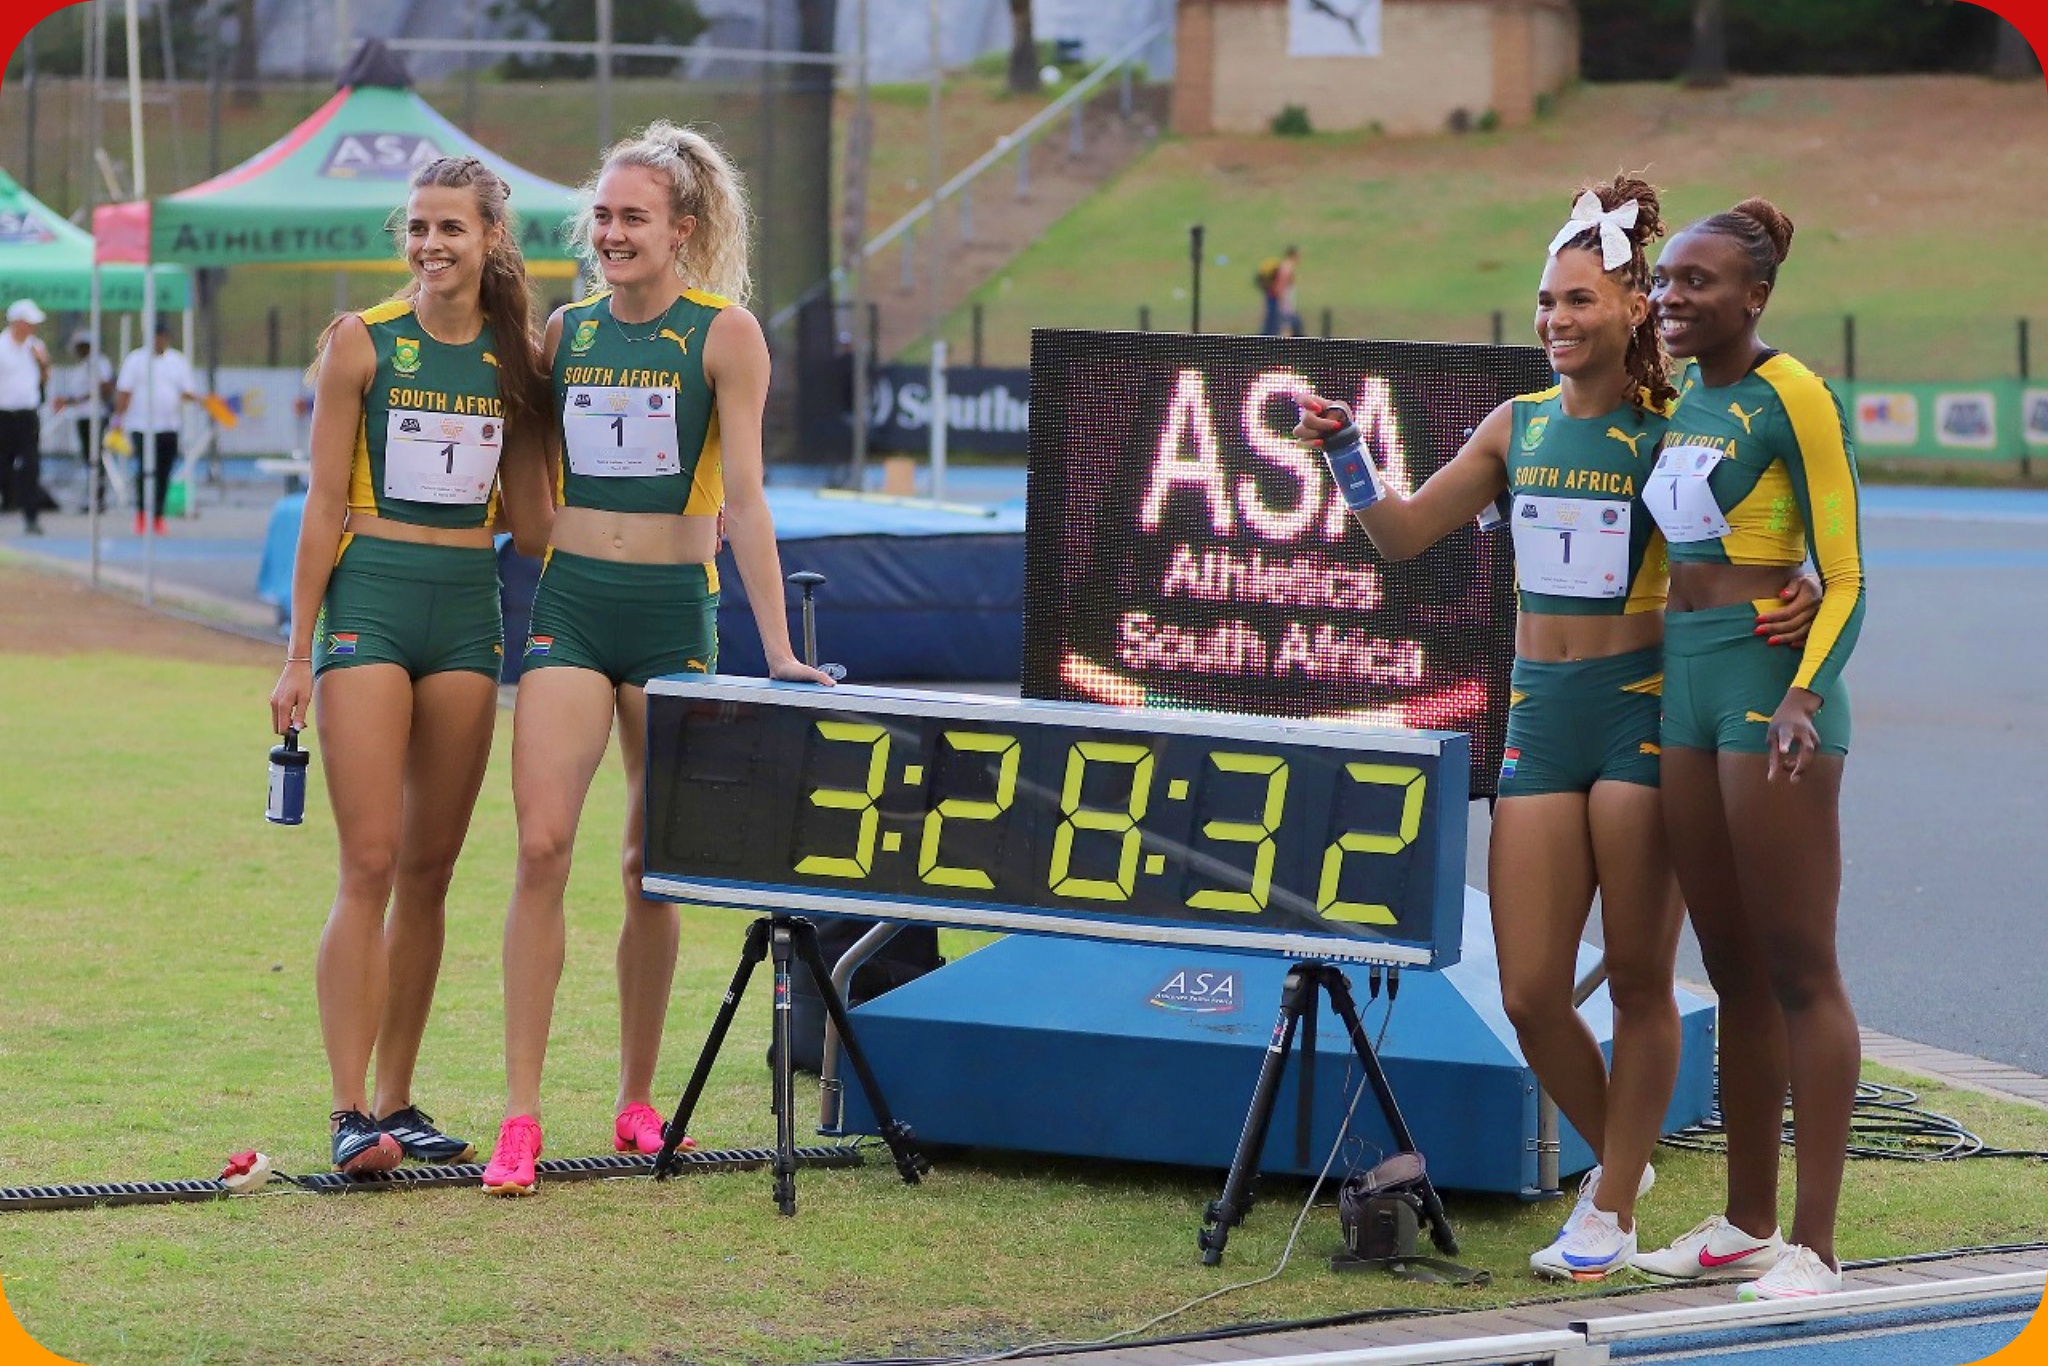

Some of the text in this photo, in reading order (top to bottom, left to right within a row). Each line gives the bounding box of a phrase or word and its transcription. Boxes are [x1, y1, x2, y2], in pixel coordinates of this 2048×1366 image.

[332, 135, 443, 165] ASA
[564, 366, 682, 394] SOUTH AFRICA
[388, 387, 503, 417] SOUTH AFRIC
[611, 416, 623, 447] 1
[441, 443, 454, 474] 1
[1514, 466, 1635, 496] SOUTH AFRICA
[1669, 477, 1678, 510] 1
[1559, 531, 1572, 564] 1
[793, 720, 1428, 926] 3:28:32
[1161, 971, 1233, 998] ASA
